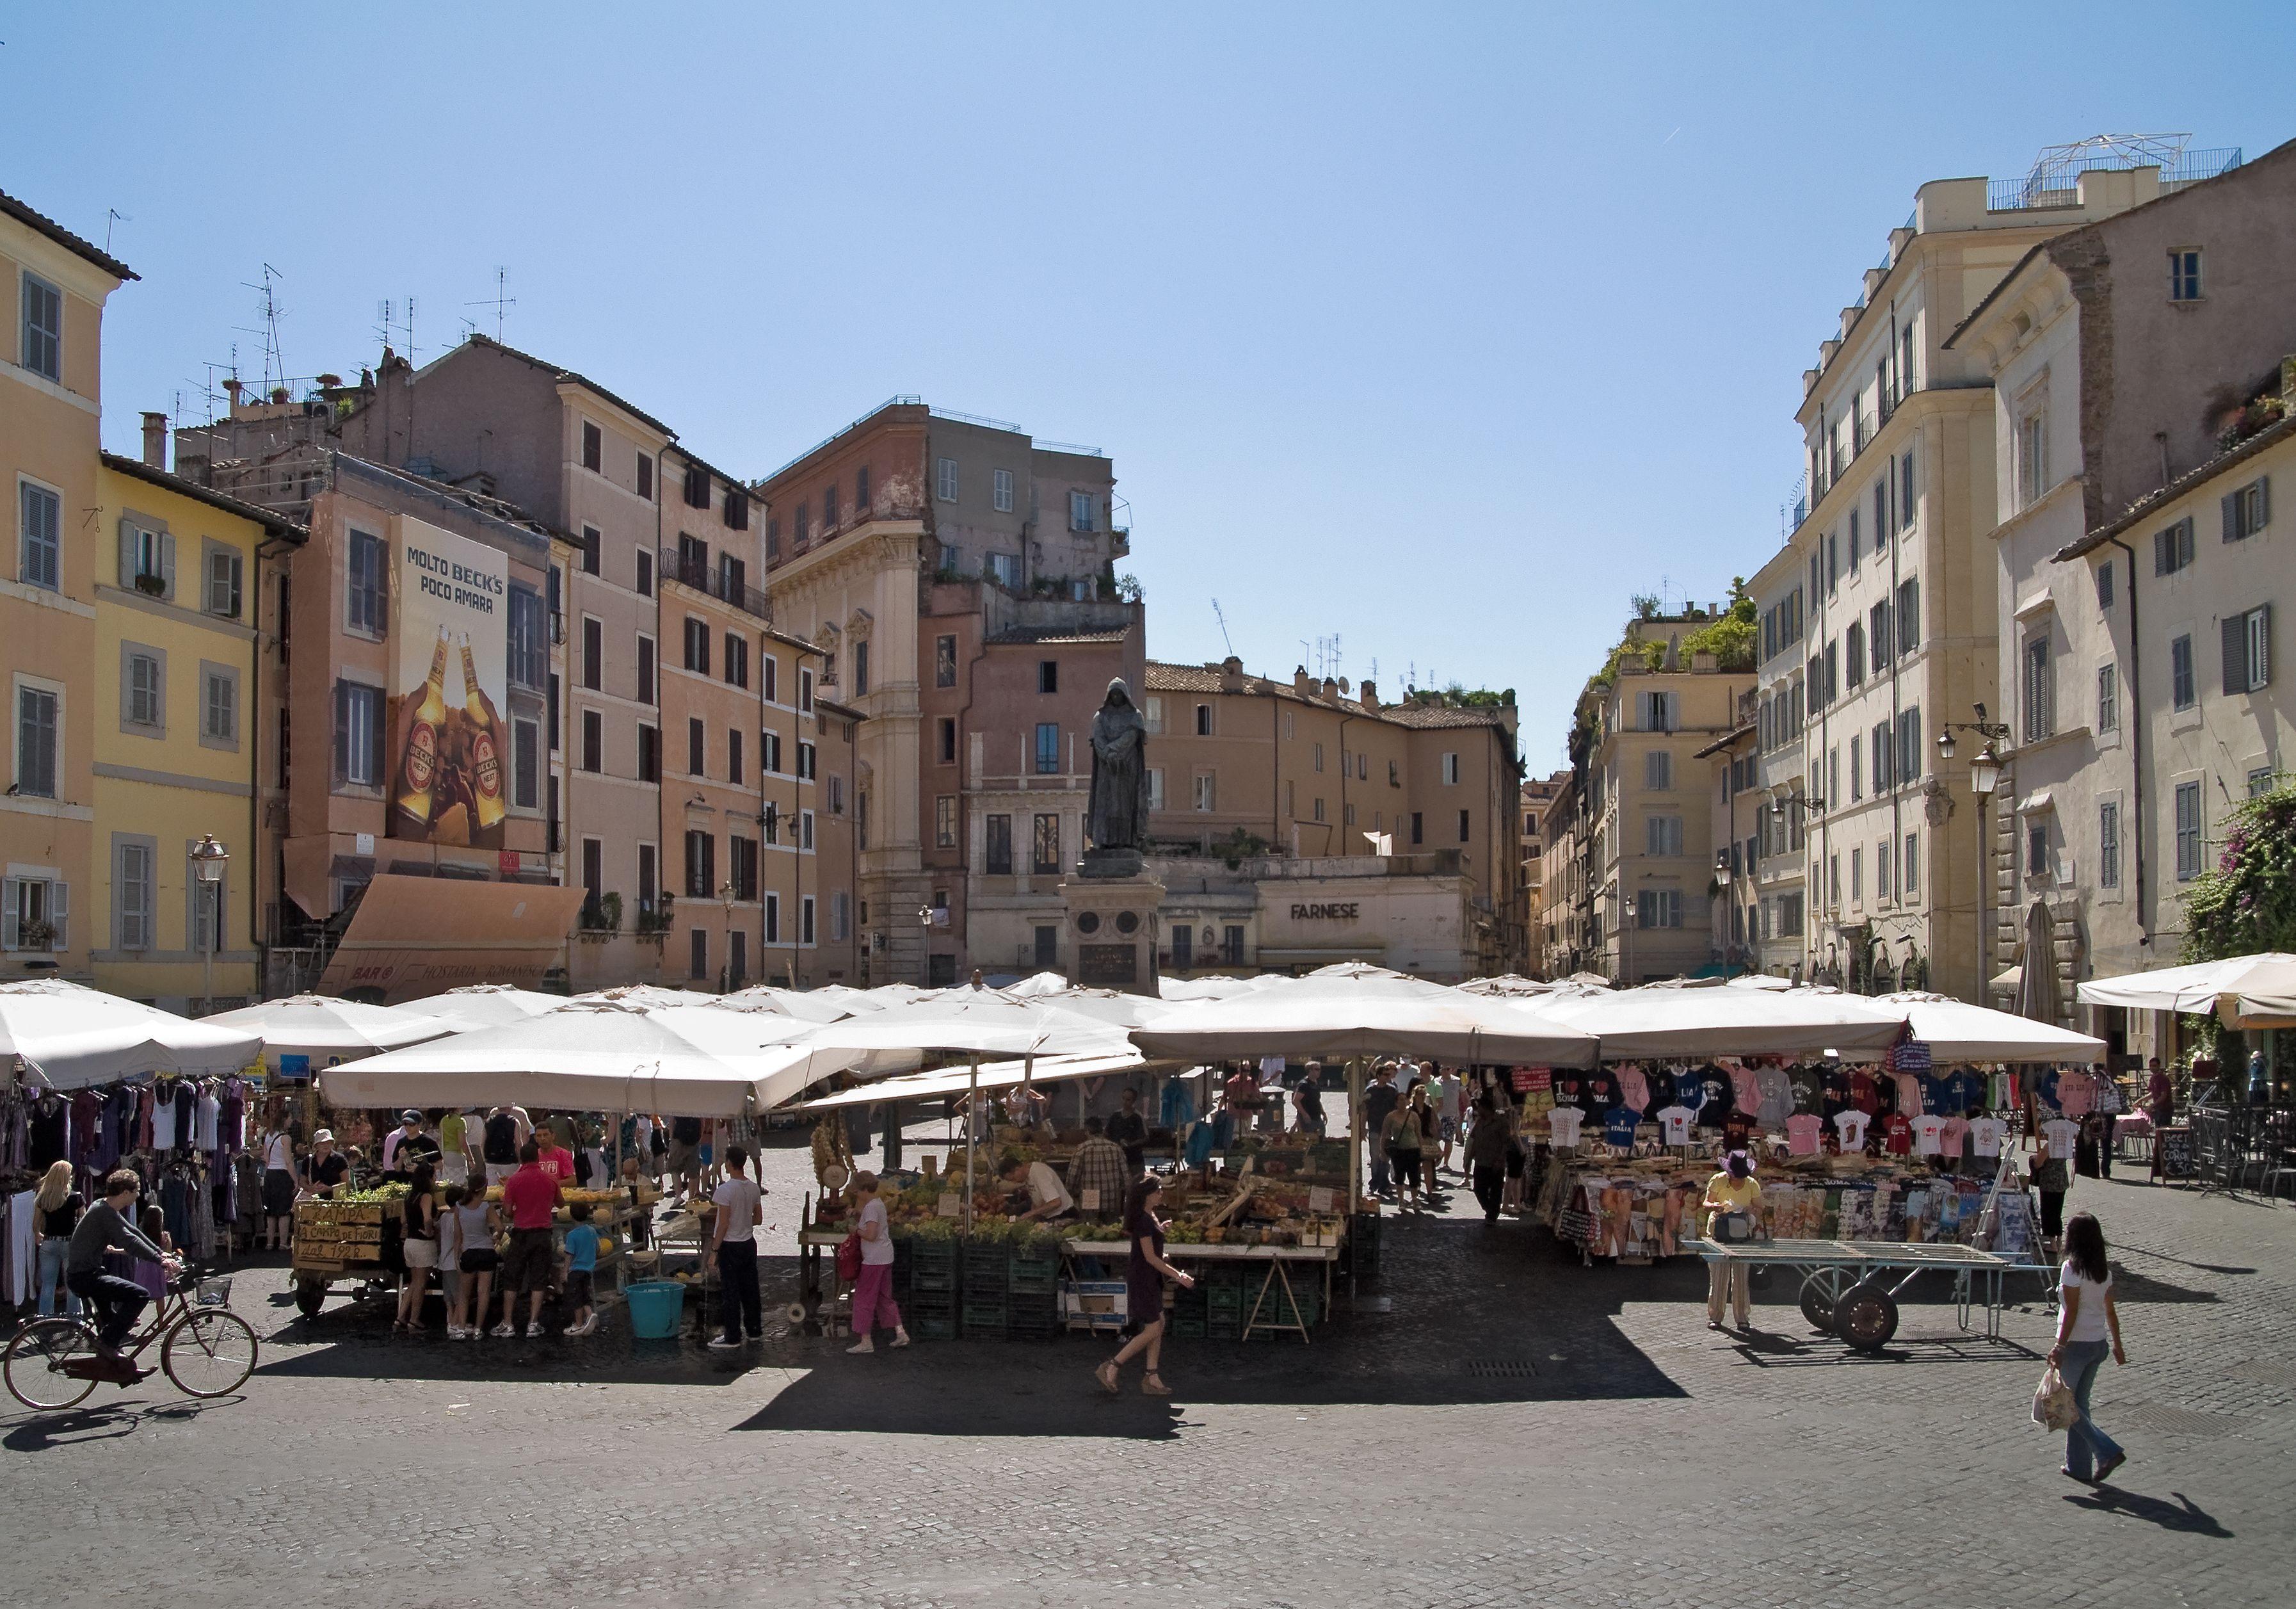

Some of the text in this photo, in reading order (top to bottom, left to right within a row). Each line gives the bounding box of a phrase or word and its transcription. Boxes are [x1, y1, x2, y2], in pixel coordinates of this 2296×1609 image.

[408, 546, 503, 595] MOLTO BECK'S
[421, 575, 493, 615] POCO AMARA
[1290, 903, 1360, 920] FARNESE
[353, 967, 380, 980] BAR
[422, 964, 476, 980] HOSTARIA
[1555, 1081, 1564, 1096] I
[1681, 1088, 1694, 1097] LIA
[1727, 1122, 1746, 1133] ROMA
[310, 1227, 340, 1238] CAMPO
[342, 1231, 354, 1240] DE
[354, 1227, 377, 1241] FIORI
[301, 1244, 324, 1256] dal
